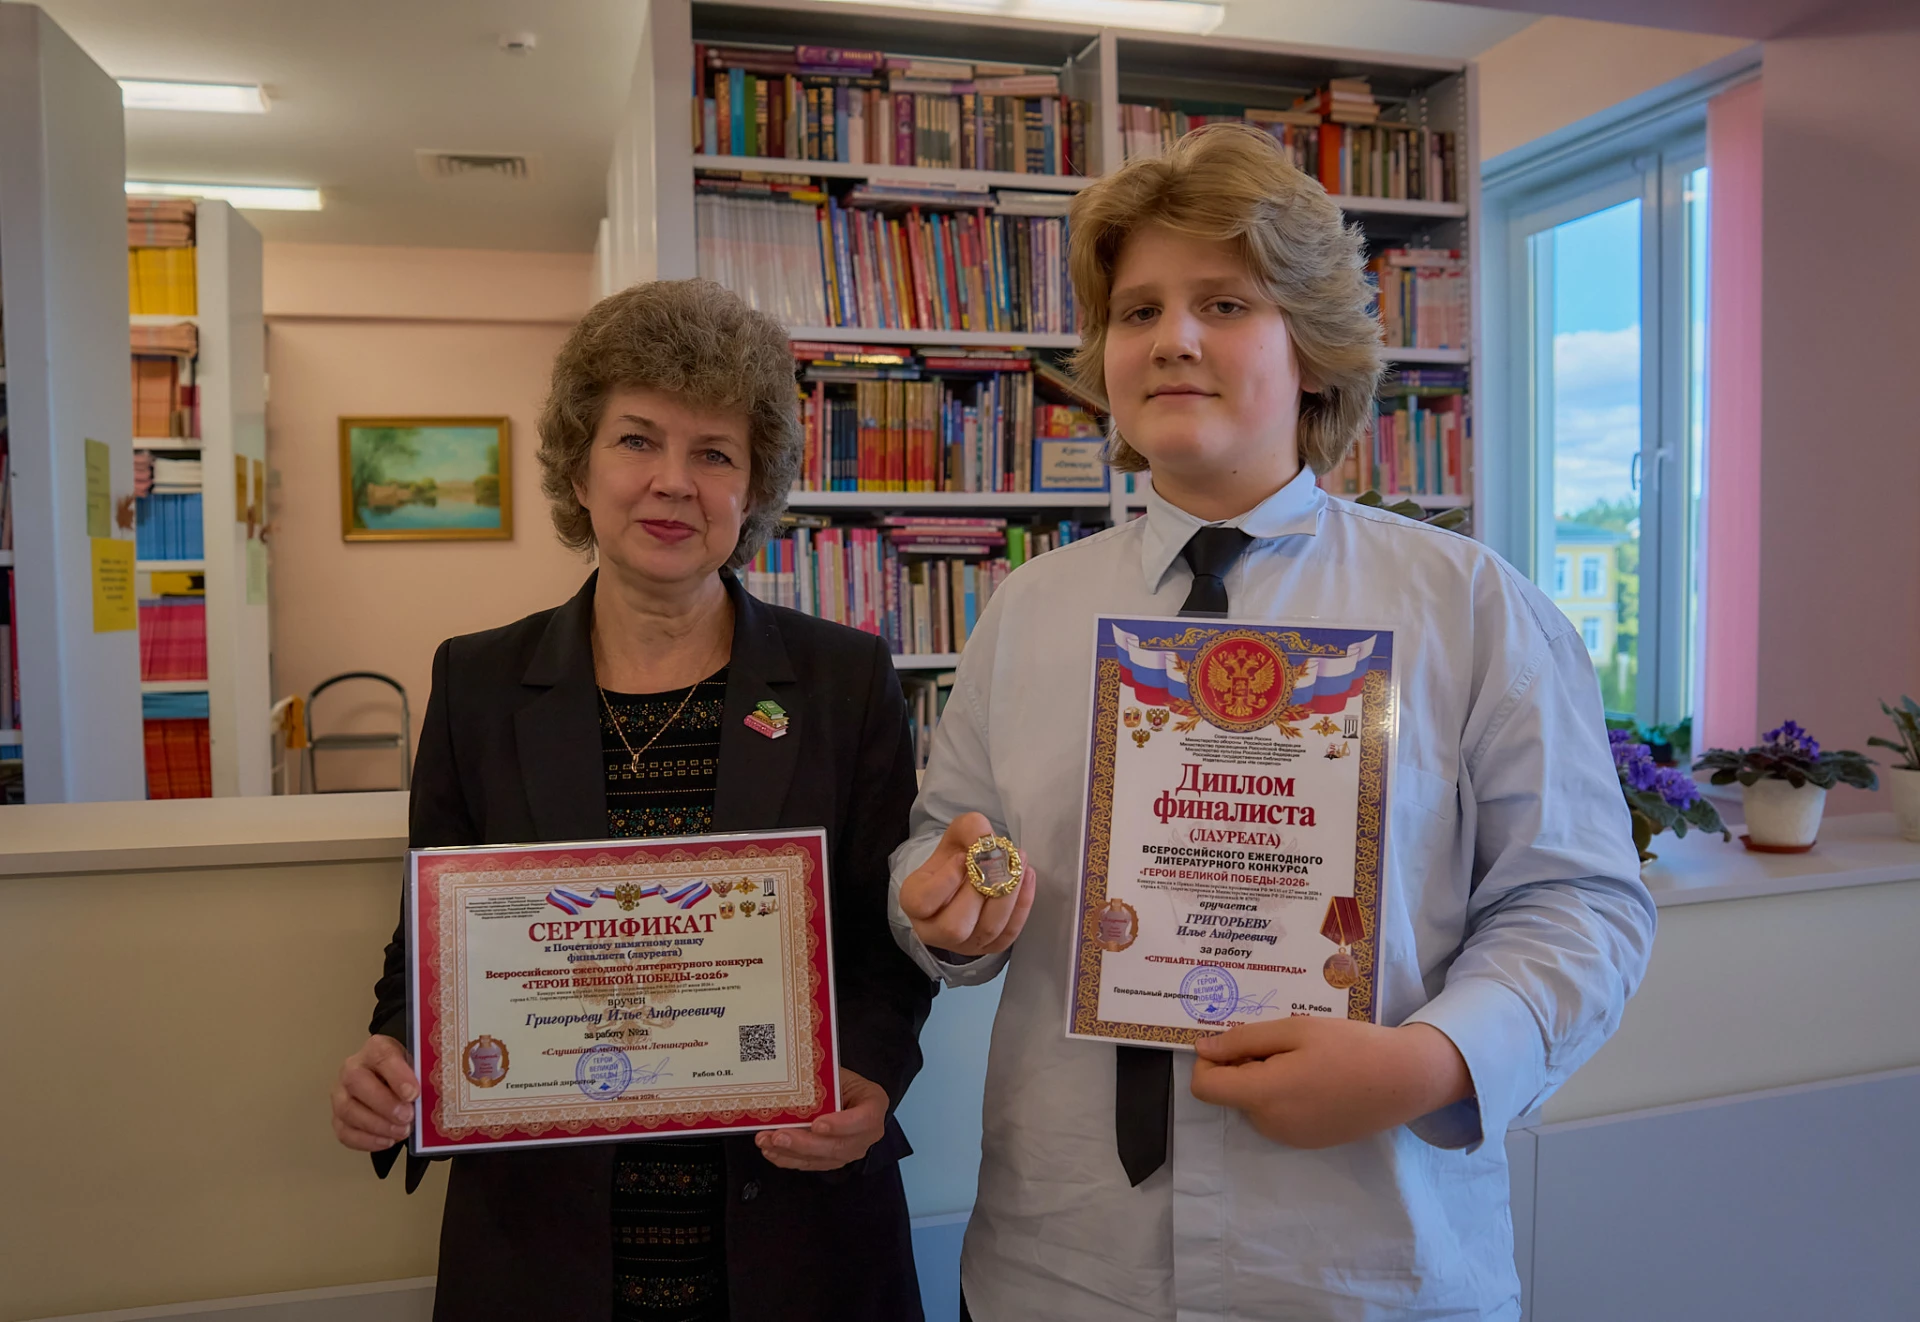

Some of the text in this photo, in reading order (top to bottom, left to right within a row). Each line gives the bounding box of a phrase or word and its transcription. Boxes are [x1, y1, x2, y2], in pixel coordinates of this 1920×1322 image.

[1175, 763, 1296, 798] Диплом
[1153, 790, 1317, 827] финалиста
[1189, 828, 1281, 849] (ЛАУРЕАТА)
[1142, 845, 1323, 865] ВСЕРОССИЙСКОГО ЕЖЕГОДНОГО
[1154, 855, 1309, 875] ЛИТЕРАТУРНОГО КОНКУРСА
[1139, 867, 1176, 878] «ГЕРОИ
[1178, 869, 1229, 881] ВЕЛИКОЙ
[1199, 901, 1258, 912] вручается
[528, 913, 717, 942] СЕРТИФИКАТ
[1185, 913, 1272, 930] ГРИГОРЬЕВУ
[1176, 926, 1279, 946] Илье Андреевичу
[544, 945, 552, 953] к
[614, 939, 672, 949] памятному
[674, 937, 705, 947] знаку
[1199, 946, 1253, 959] за работу
[567, 947, 683, 963] финалиста (лауреата)
[486, 957, 763, 980] Всероссийского ежегодного литературного конкурса
[1144, 955, 1307, 975] «СЛУШАЙТЕ МЕТРОНОМ ЛЕНИНГРАДА»
[522, 979, 570, 990] «ГЕРОИ
[572, 973, 634, 988] ВЕЛИКОЙ
[636, 970, 729, 985] ПОБЕДЫ-2026»
[1197, 977, 1218, 986] ГЕРОИ
[1113, 986, 1199, 1001] Генеральный директор
[607, 996, 646, 1008] вручен
[1308, 1004, 1332, 1013] Рябов
[525, 1005, 726, 1028] Григорьеву Илье Андреевичу
[1197, 1018, 1225, 1027] Москва
[595, 1028, 625, 1041] работу
[628, 1028, 649, 1037] №21
[648, 1040, 709, 1050] Ленинграда»
[692, 1070, 715, 1078] Рябов
[506, 1078, 597, 1089] Генеральный директор
